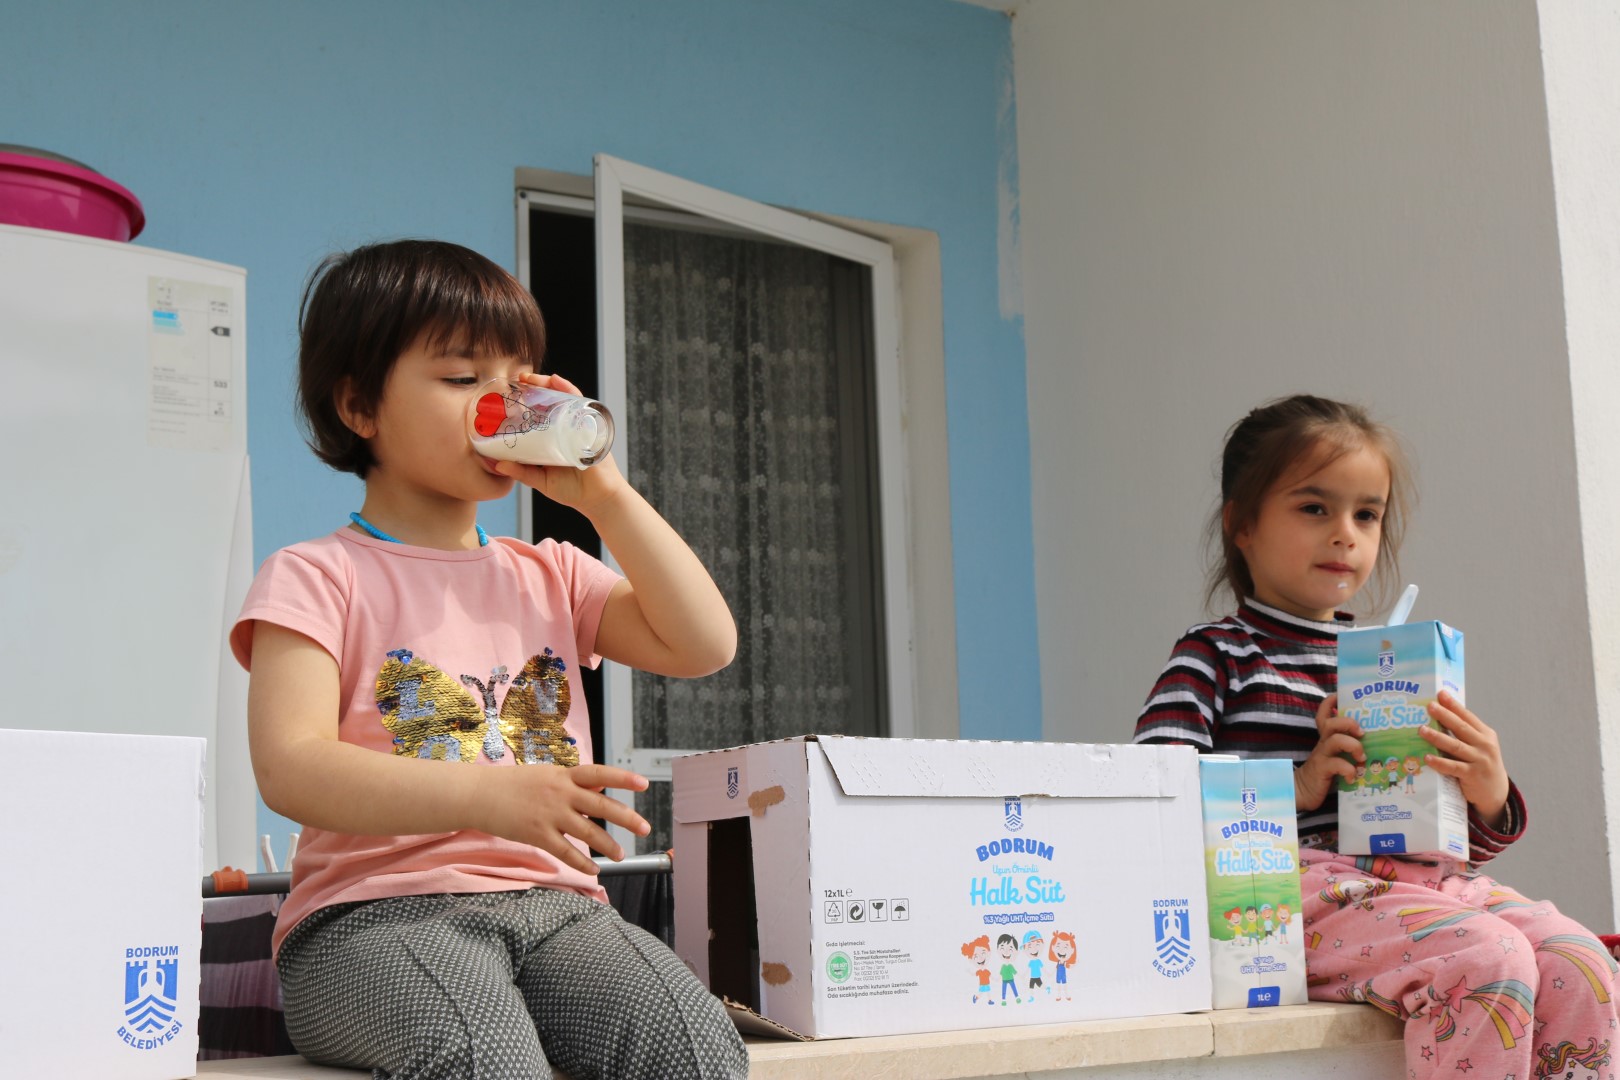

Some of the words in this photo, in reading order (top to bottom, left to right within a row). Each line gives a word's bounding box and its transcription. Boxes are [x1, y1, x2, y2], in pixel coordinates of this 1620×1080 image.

[1352, 680, 1420, 700] BODRUM
[1391, 706, 1428, 726] Süt
[1222, 820, 1283, 838] BODRUM
[976, 838, 1054, 862] BODRUM
[992, 865, 1010, 876] Uzun
[1217, 850, 1260, 873] Halk
[1261, 849, 1293, 870] Süt
[824, 890, 844, 898] 12x1L
[970, 876, 1023, 906] Halk
[1026, 876, 1066, 904] Süt
[1153, 899, 1188, 907] BODRUM
[126, 946, 178, 958] BODRUM
[1152, 956, 1196, 978] BELEDİYESİ
[116, 1020, 183, 1050] BELEDİYESİ
